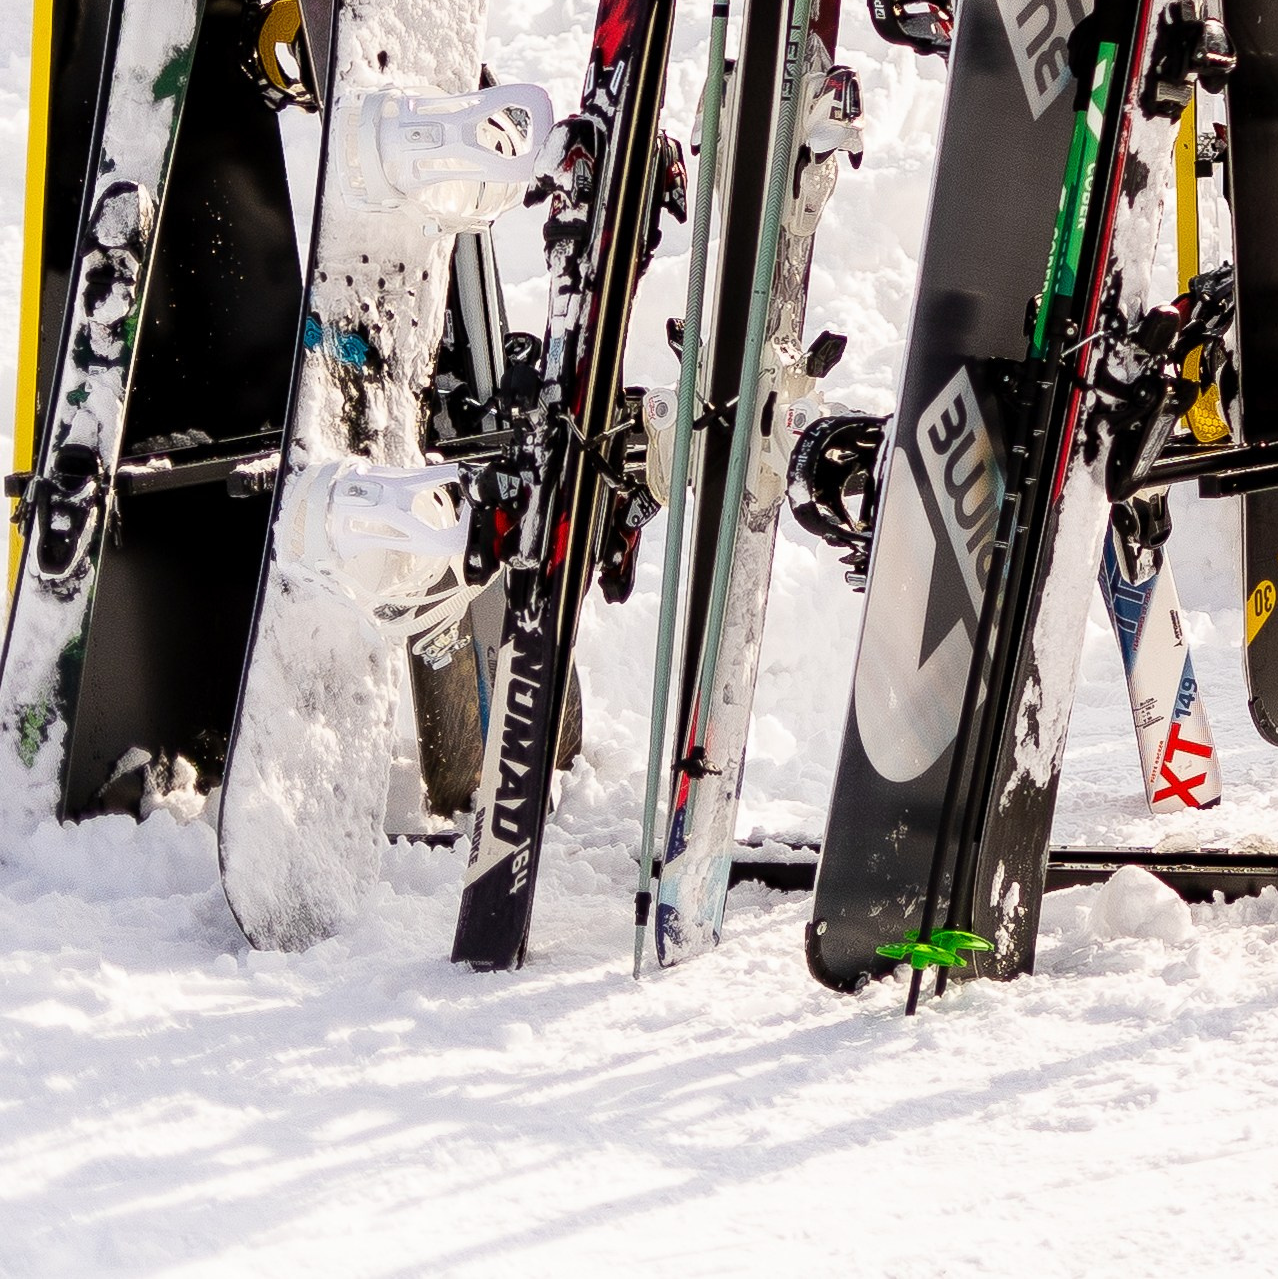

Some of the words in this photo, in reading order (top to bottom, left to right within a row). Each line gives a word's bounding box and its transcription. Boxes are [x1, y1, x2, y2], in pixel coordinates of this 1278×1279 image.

[1253, 585, 1276, 617] 30
[1175, 677, 1198, 719] 149
[491, 637, 542, 847] NOMAD
[1151, 721, 1214, 810] XT
[509, 837, 531, 896] 164
